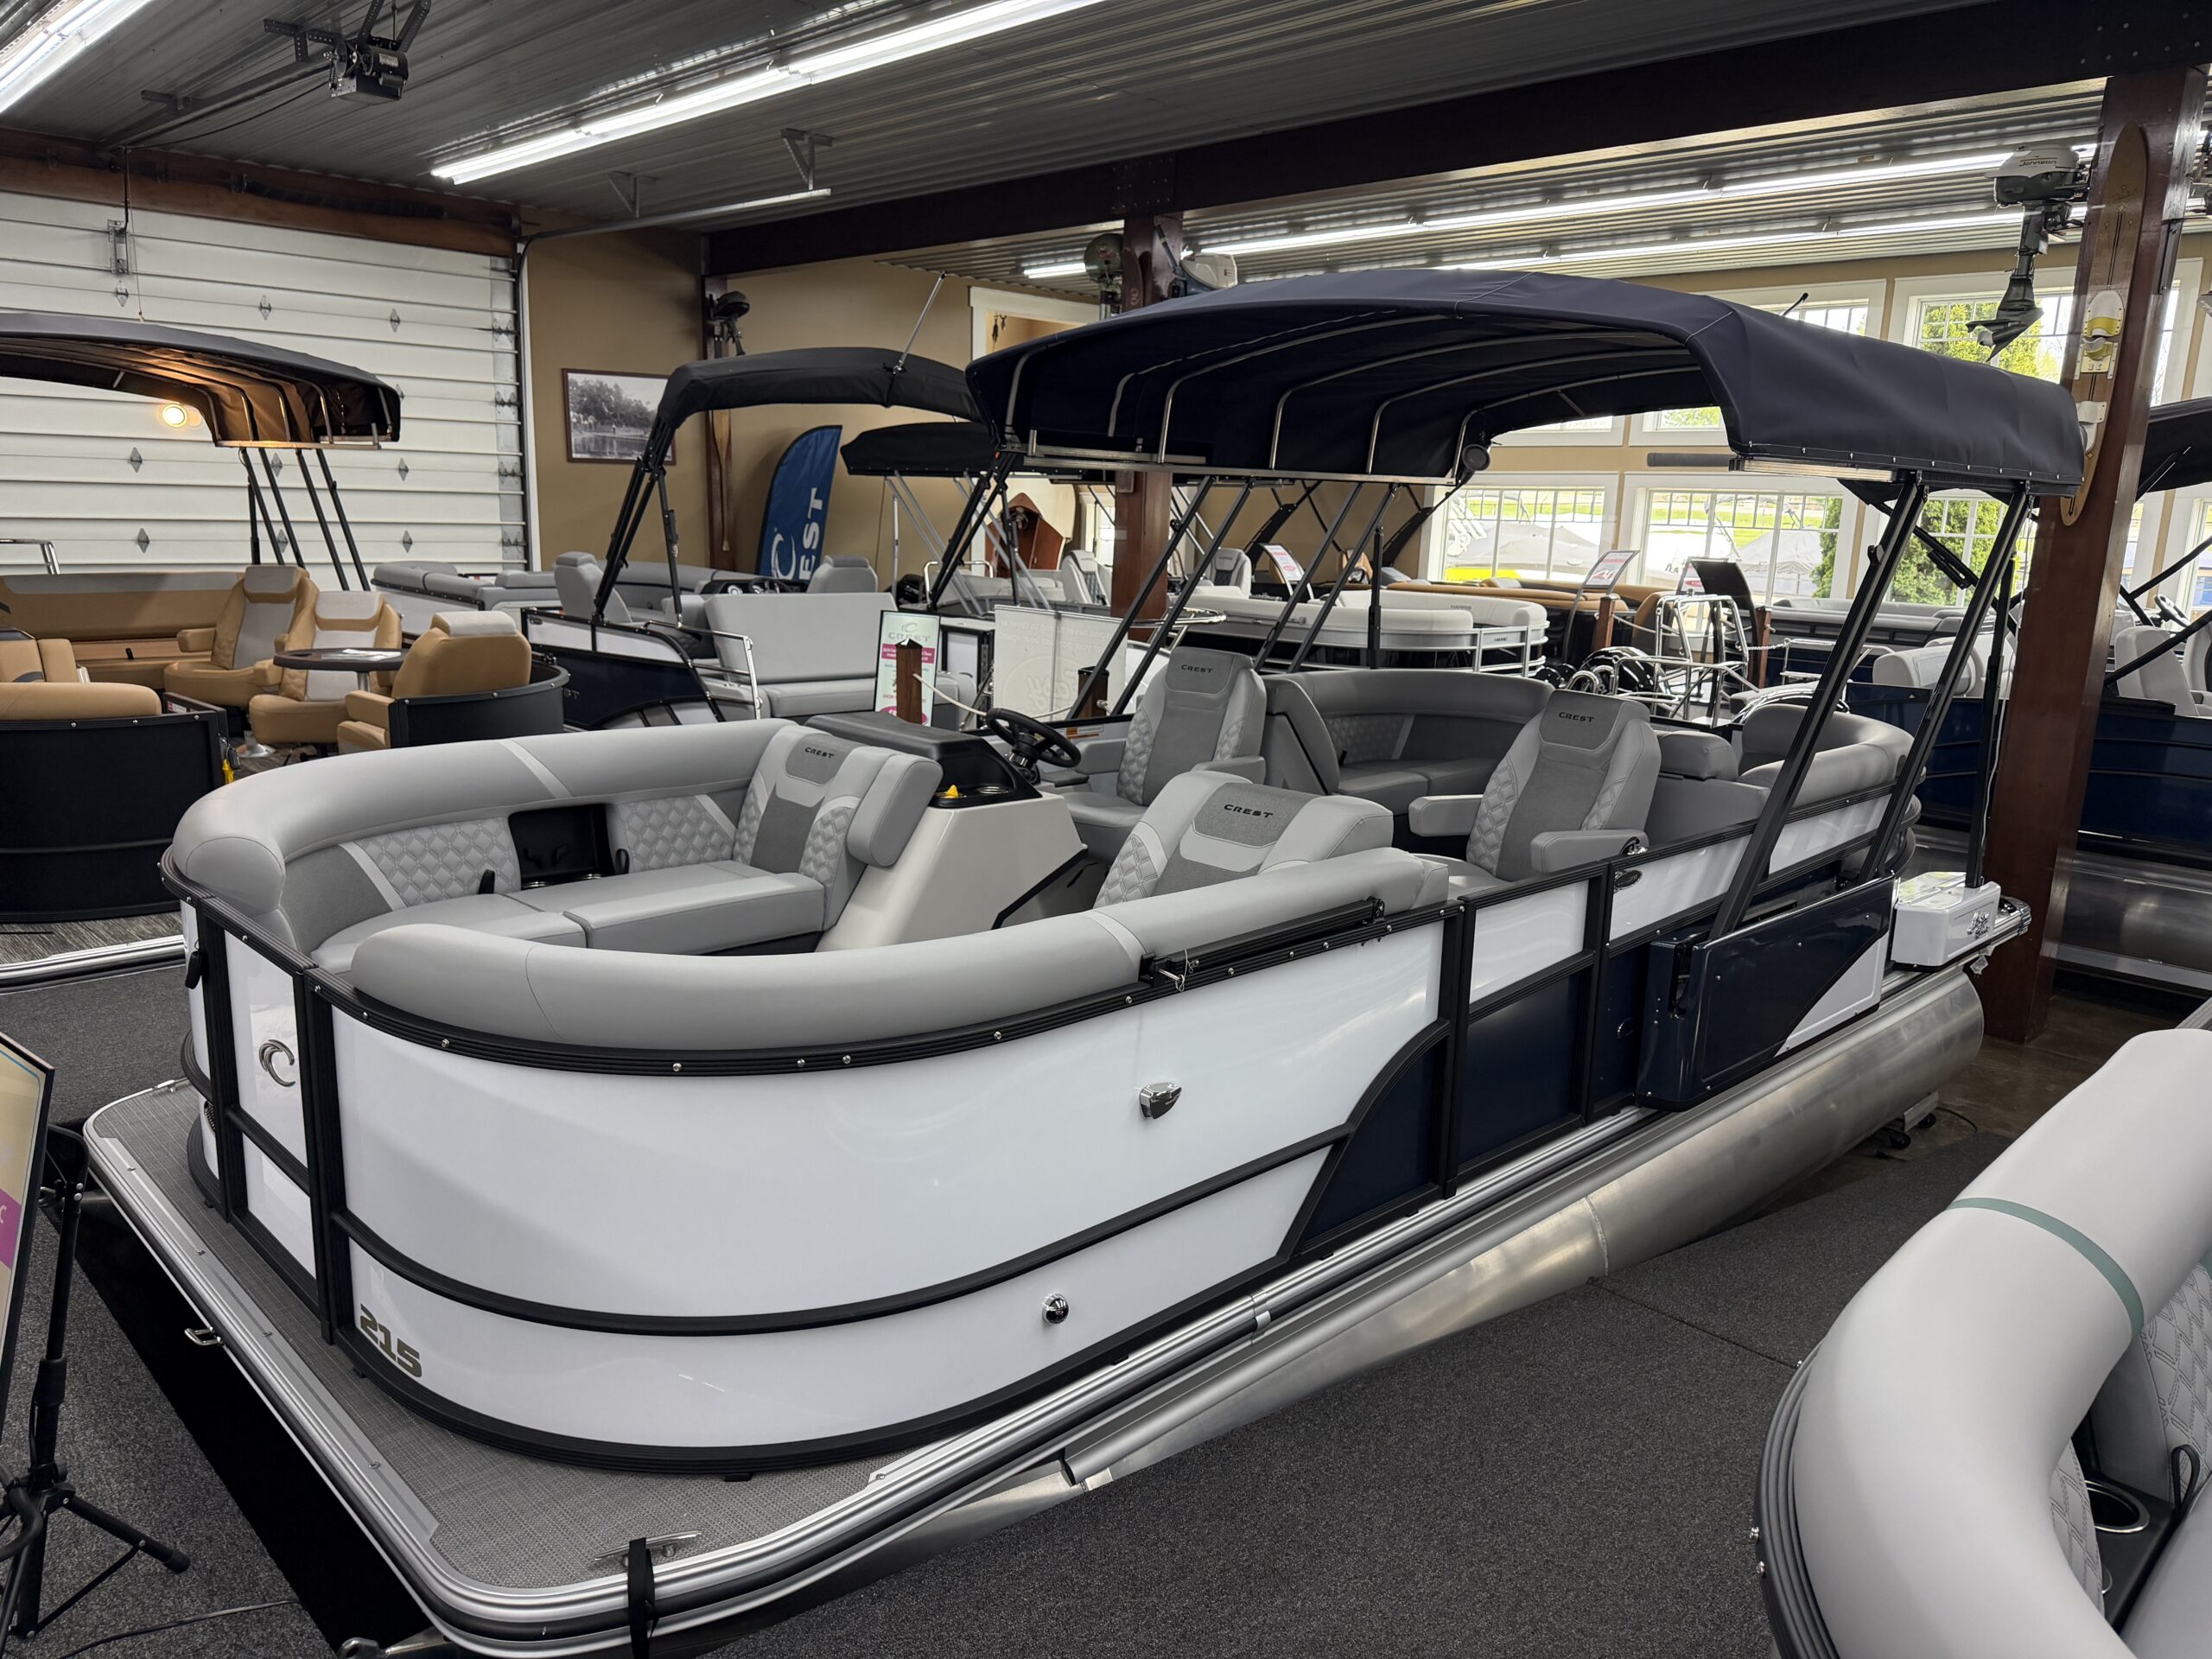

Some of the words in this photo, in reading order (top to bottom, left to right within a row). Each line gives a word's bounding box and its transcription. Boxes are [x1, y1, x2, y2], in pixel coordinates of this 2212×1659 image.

[2018, 158, 2057, 167] Johnson
[798, 487, 823, 582] EST
[1181, 664, 1213, 673] CREST
[1558, 711, 1595, 722] CREST
[804, 747, 835, 759] CREST
[1224, 804, 1274, 818] CREST
[359, 1302, 423, 1378] 215
